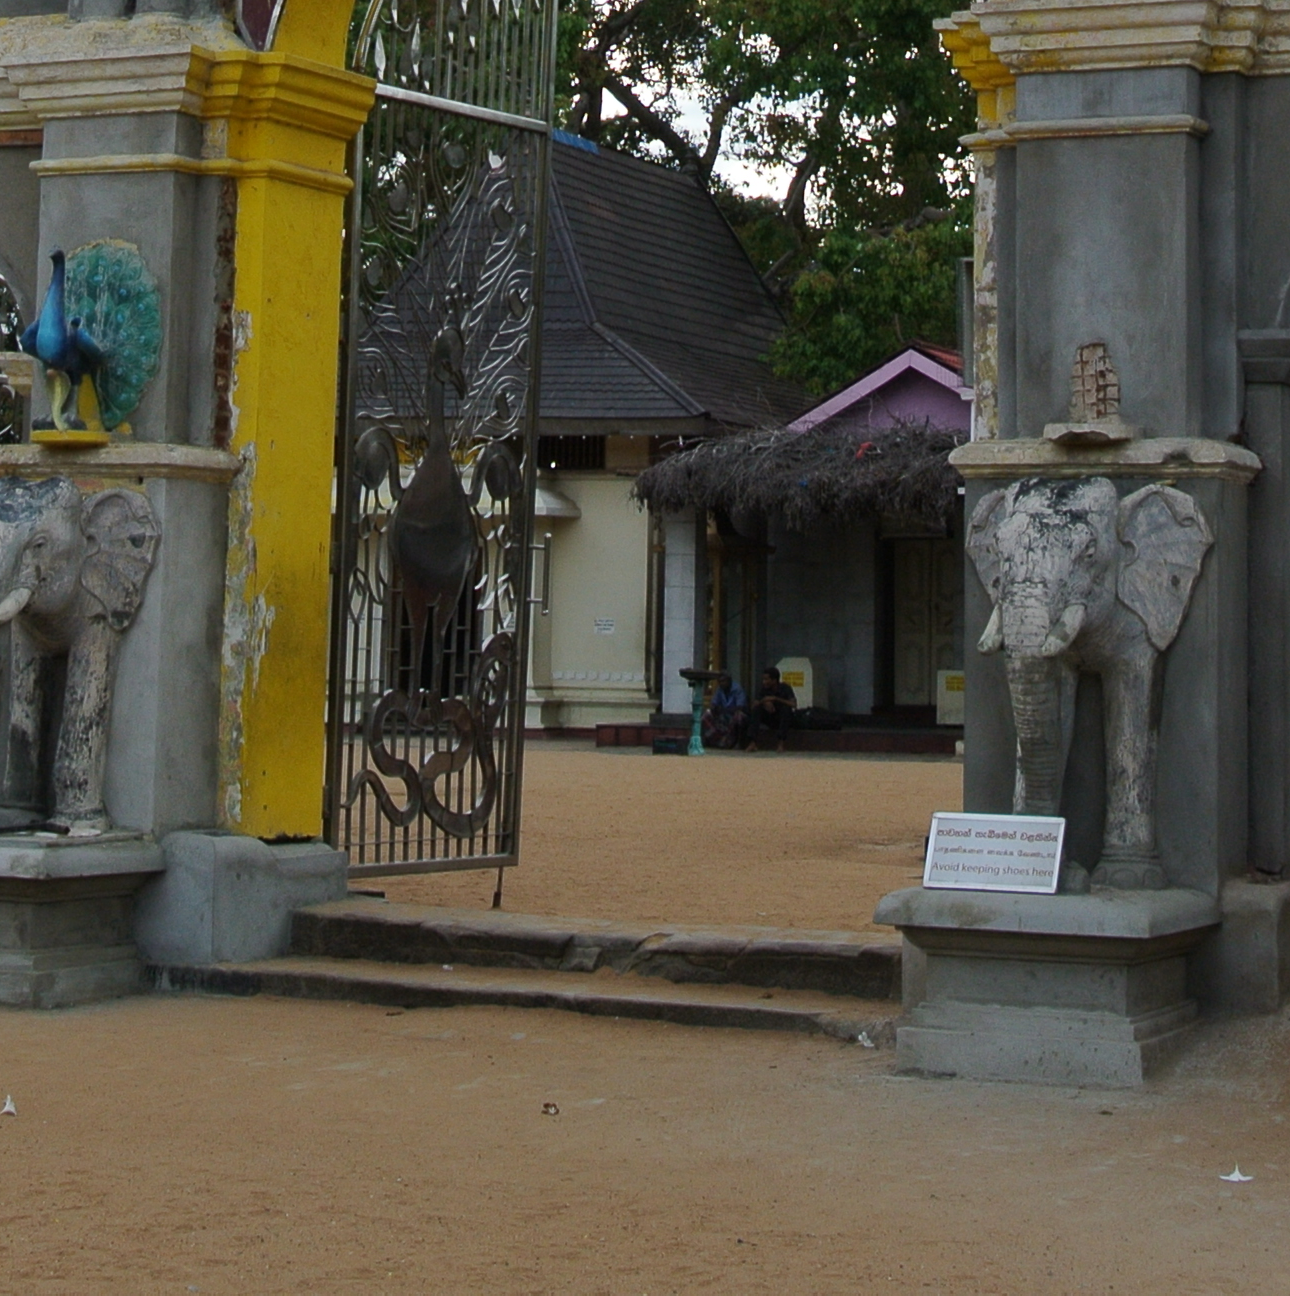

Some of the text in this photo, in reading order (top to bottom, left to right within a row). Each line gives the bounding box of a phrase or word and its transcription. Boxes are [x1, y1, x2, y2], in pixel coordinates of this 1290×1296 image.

[932, 862, 1054, 877] Avoid keeping shoes here
